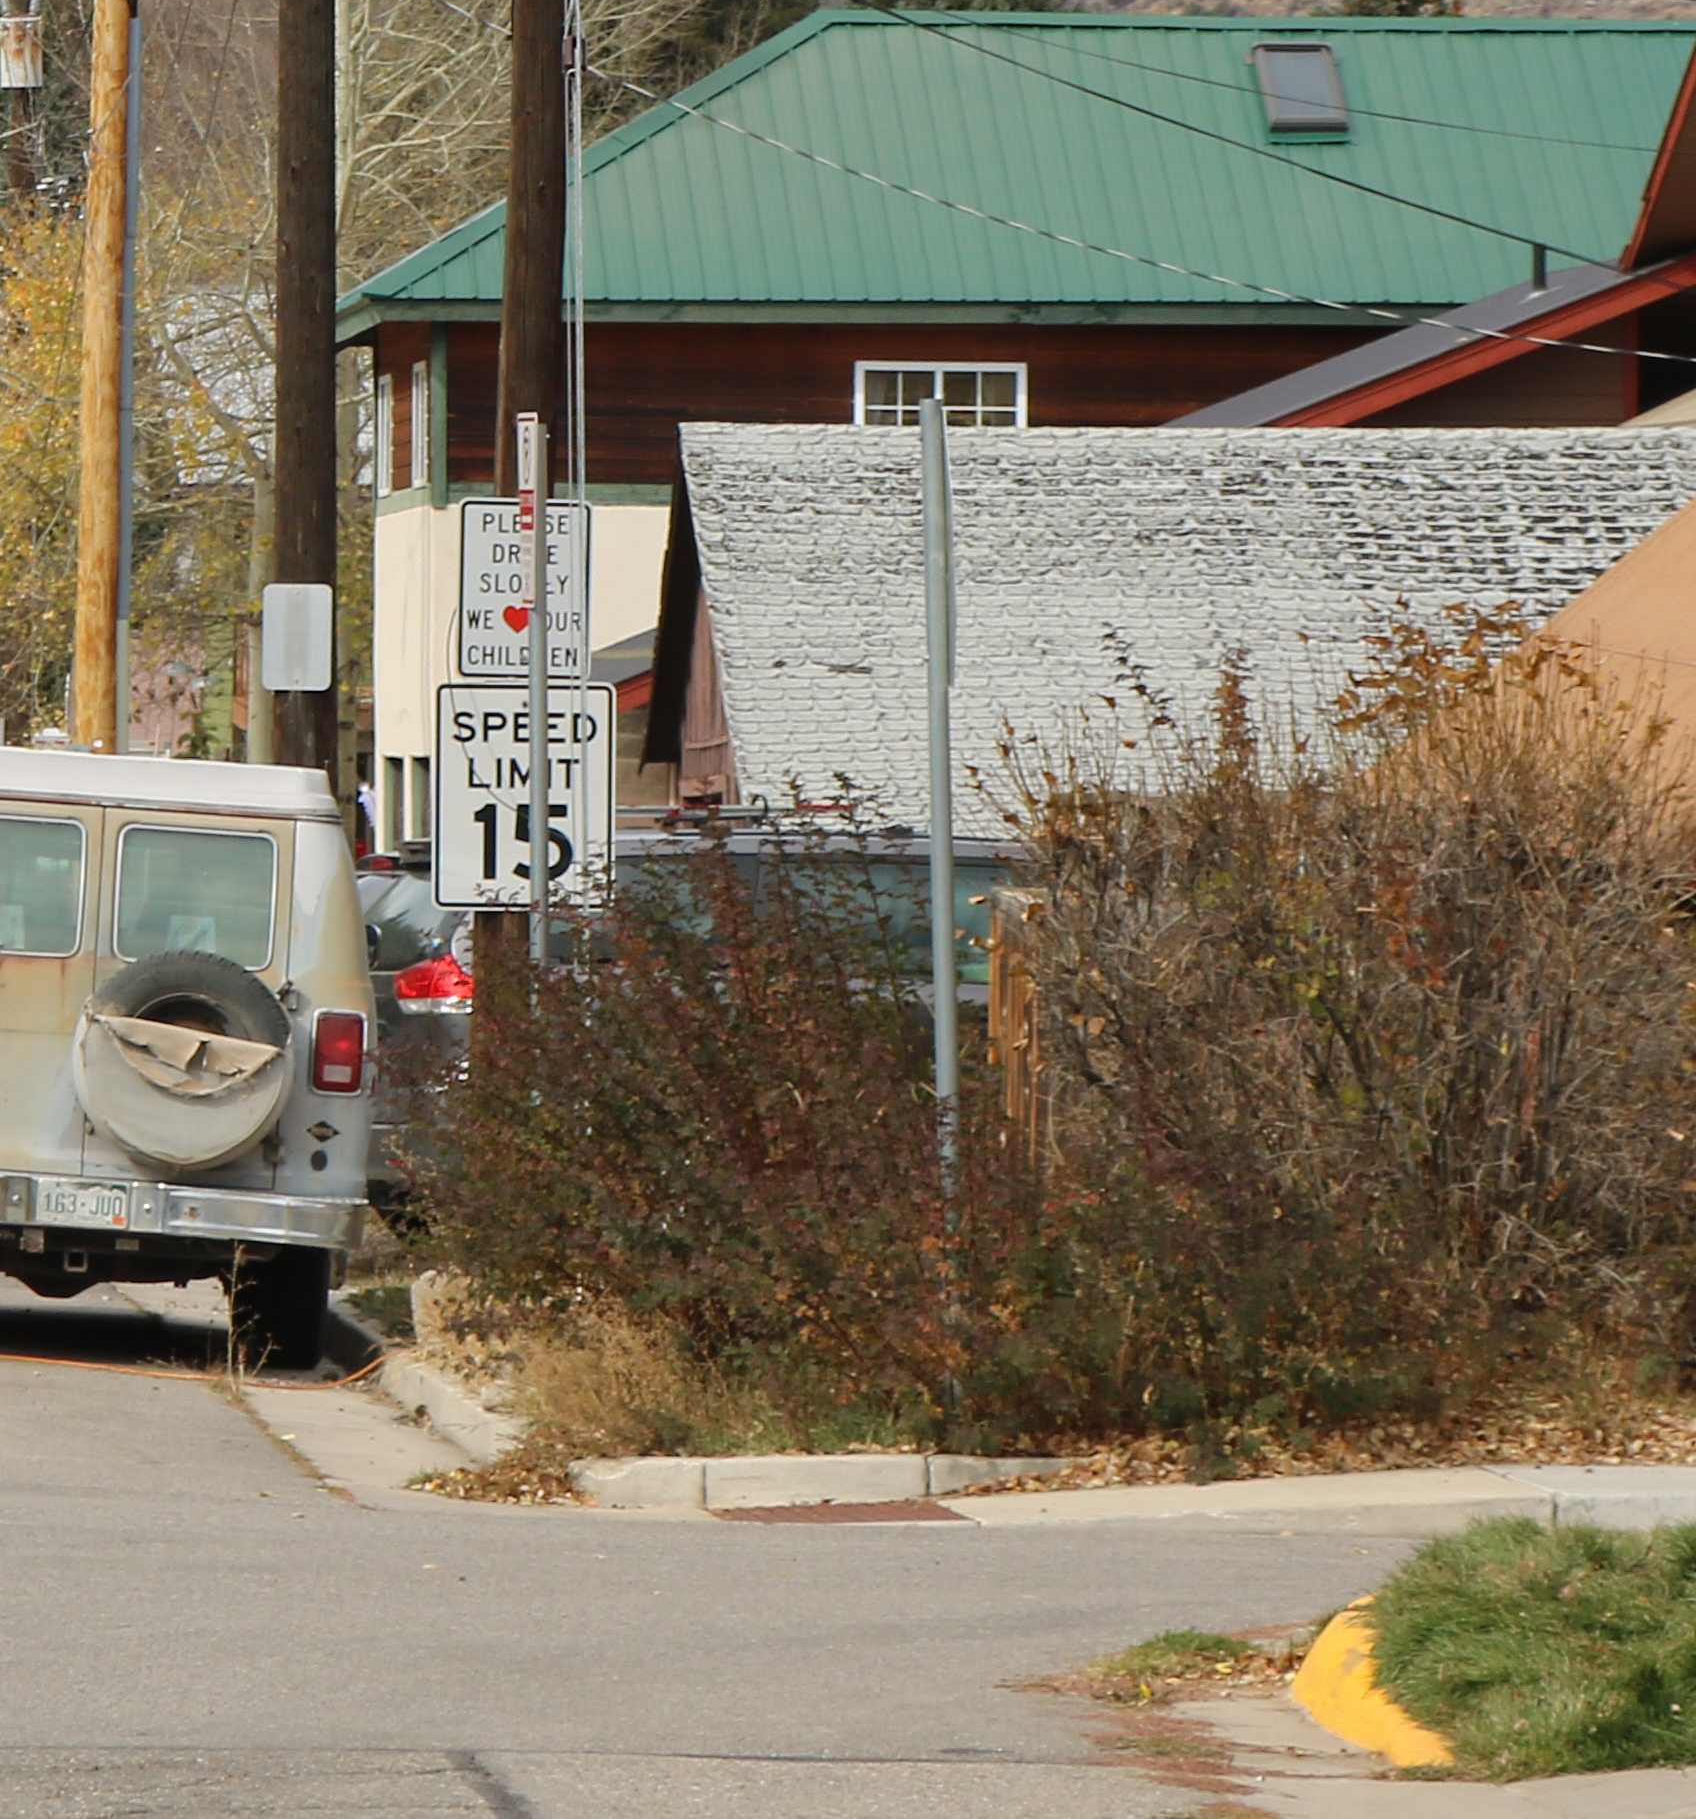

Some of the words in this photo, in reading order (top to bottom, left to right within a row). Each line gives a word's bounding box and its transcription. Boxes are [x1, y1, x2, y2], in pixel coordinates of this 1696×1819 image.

[482, 513, 569, 535] PLESE
[492, 544, 559, 565] DRE
[479, 573, 569, 595] SLOY
[467, 609, 494, 630] WE
[467, 645, 578, 668] CHILDEN
[453, 711, 598, 743] SPEED
[468, 758, 580, 789] LIMIT
[474, 803, 573, 881] 15
